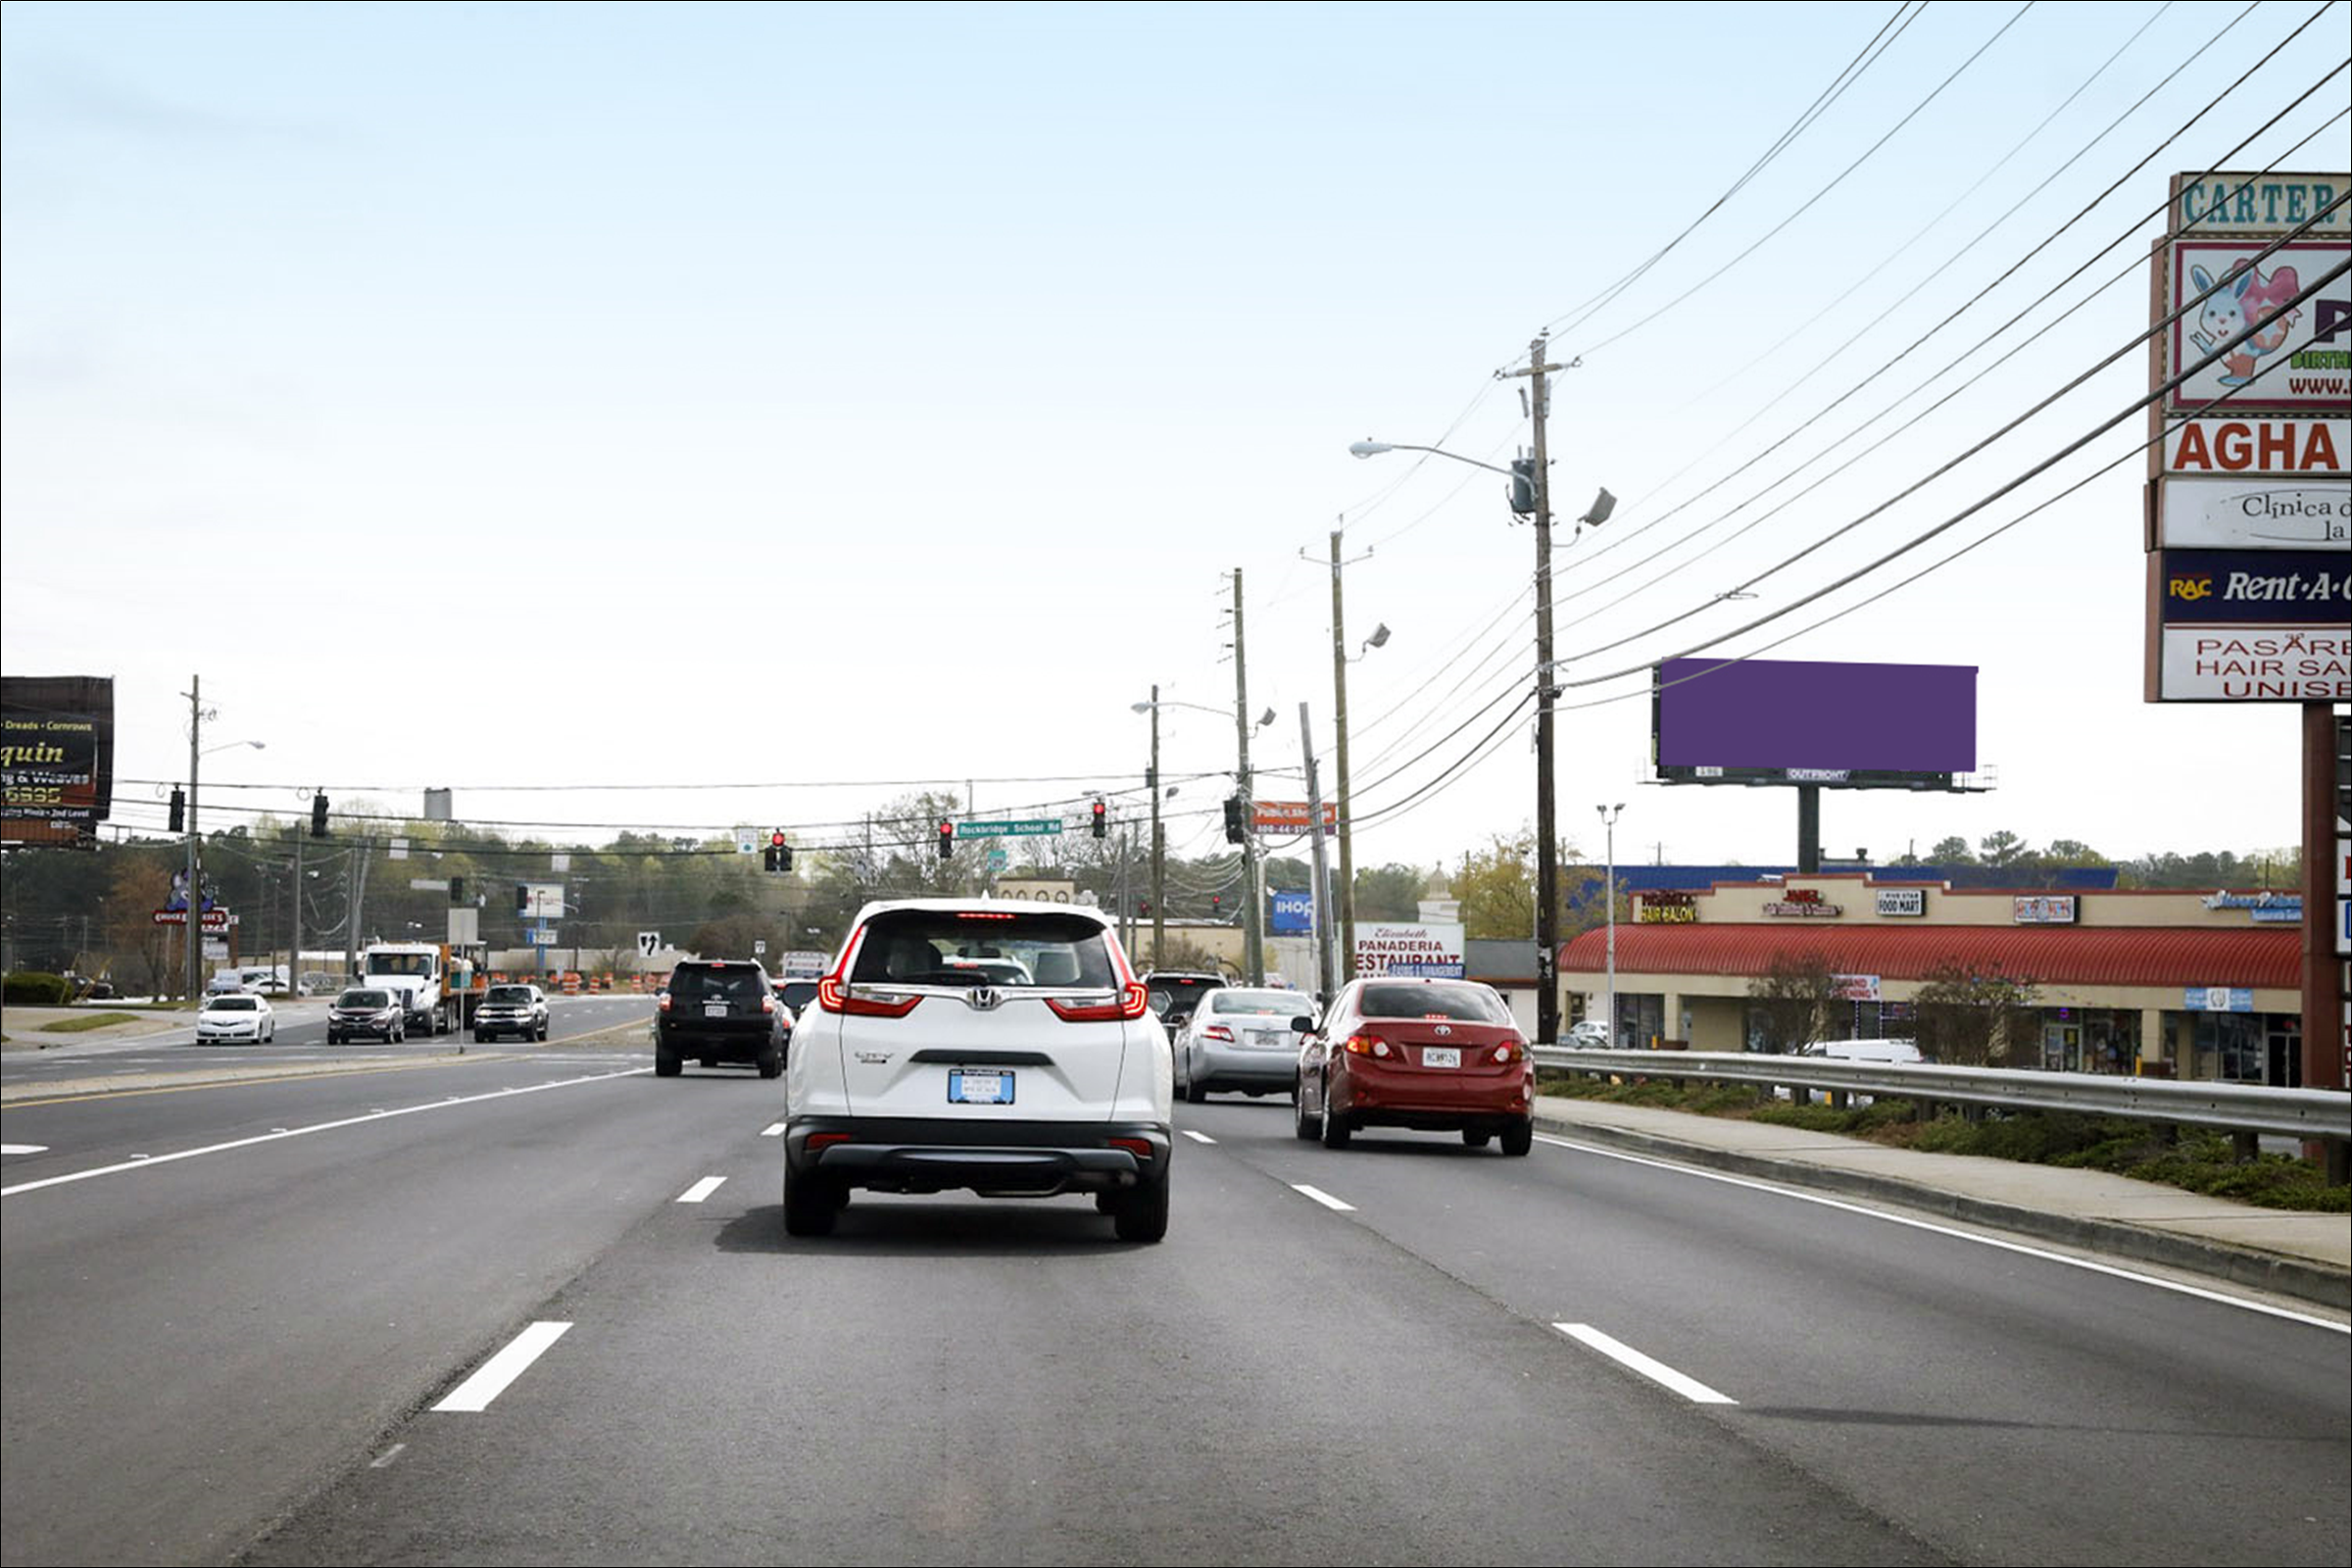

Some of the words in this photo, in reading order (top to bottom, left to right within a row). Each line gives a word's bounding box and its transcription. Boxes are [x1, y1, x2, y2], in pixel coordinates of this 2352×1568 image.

[2183, 183, 2336, 224] CARTER
[2289, 377, 2351, 395] WWW.
[2173, 422, 2340, 471] AGHA
[2242, 492, 2331, 519] Clínica
[2324, 520, 2345, 541] la
[2169, 579, 2212, 601] RAC
[2196, 661, 2285, 676] HAIR
[2298, 660, 2351, 676] SA
[5, 720, 38, 730] Dreads
[46, 720, 92, 732] Cornrows
[1789, 768, 1845, 780] OUTFRONT
[69, 808, 90, 817] Level
[960, 826, 1007, 835] Rockbridge
[1642, 906, 1661, 922] HAIR
[1662, 906, 1694, 922] SALON
[1879, 900, 1897, 912] FOOD
[1899, 900, 1919, 912] MART
[1358, 941, 1444, 952] PANADERIA
